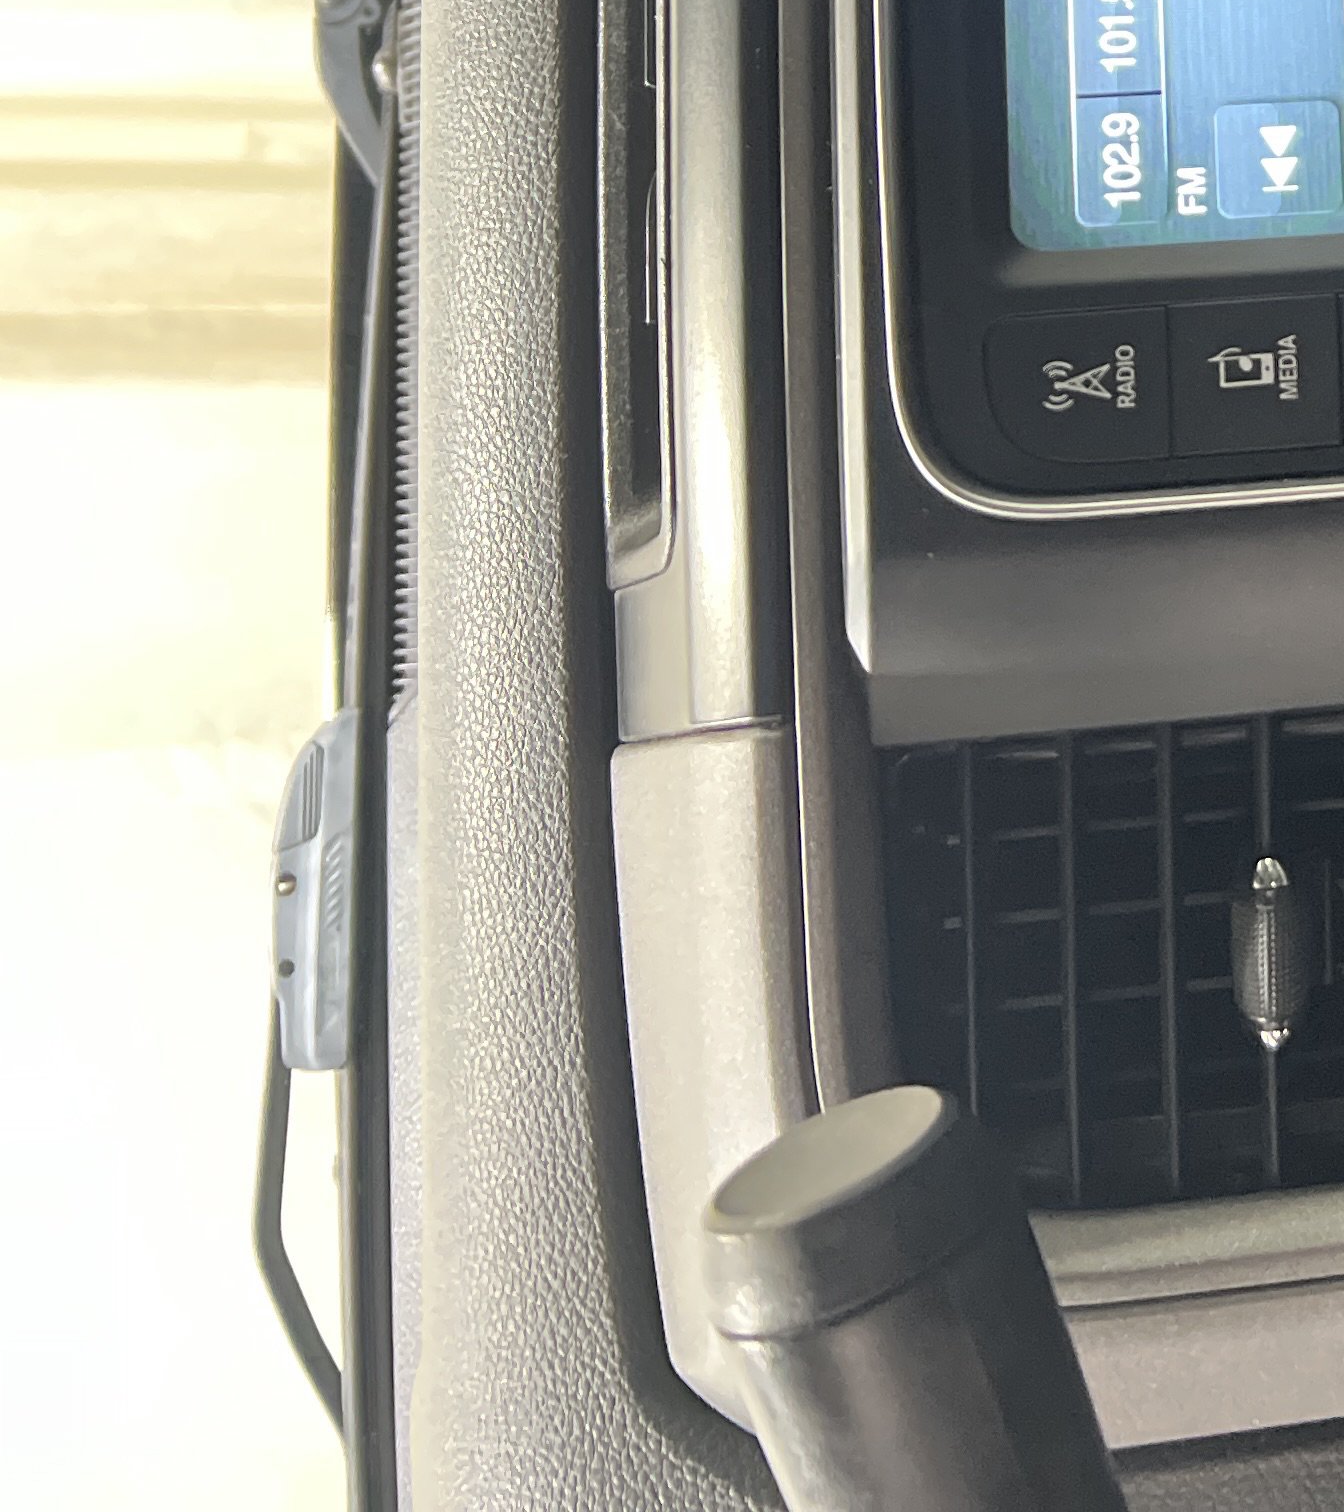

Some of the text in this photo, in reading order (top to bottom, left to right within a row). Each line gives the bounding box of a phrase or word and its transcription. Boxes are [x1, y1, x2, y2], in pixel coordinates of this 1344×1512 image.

[1101, 112, 1142, 208] 102.9
[1176, 166, 1208, 216] FM
[1115, 344, 1136, 408] RADIO
[1277, 334, 1299, 401] MEDIA
